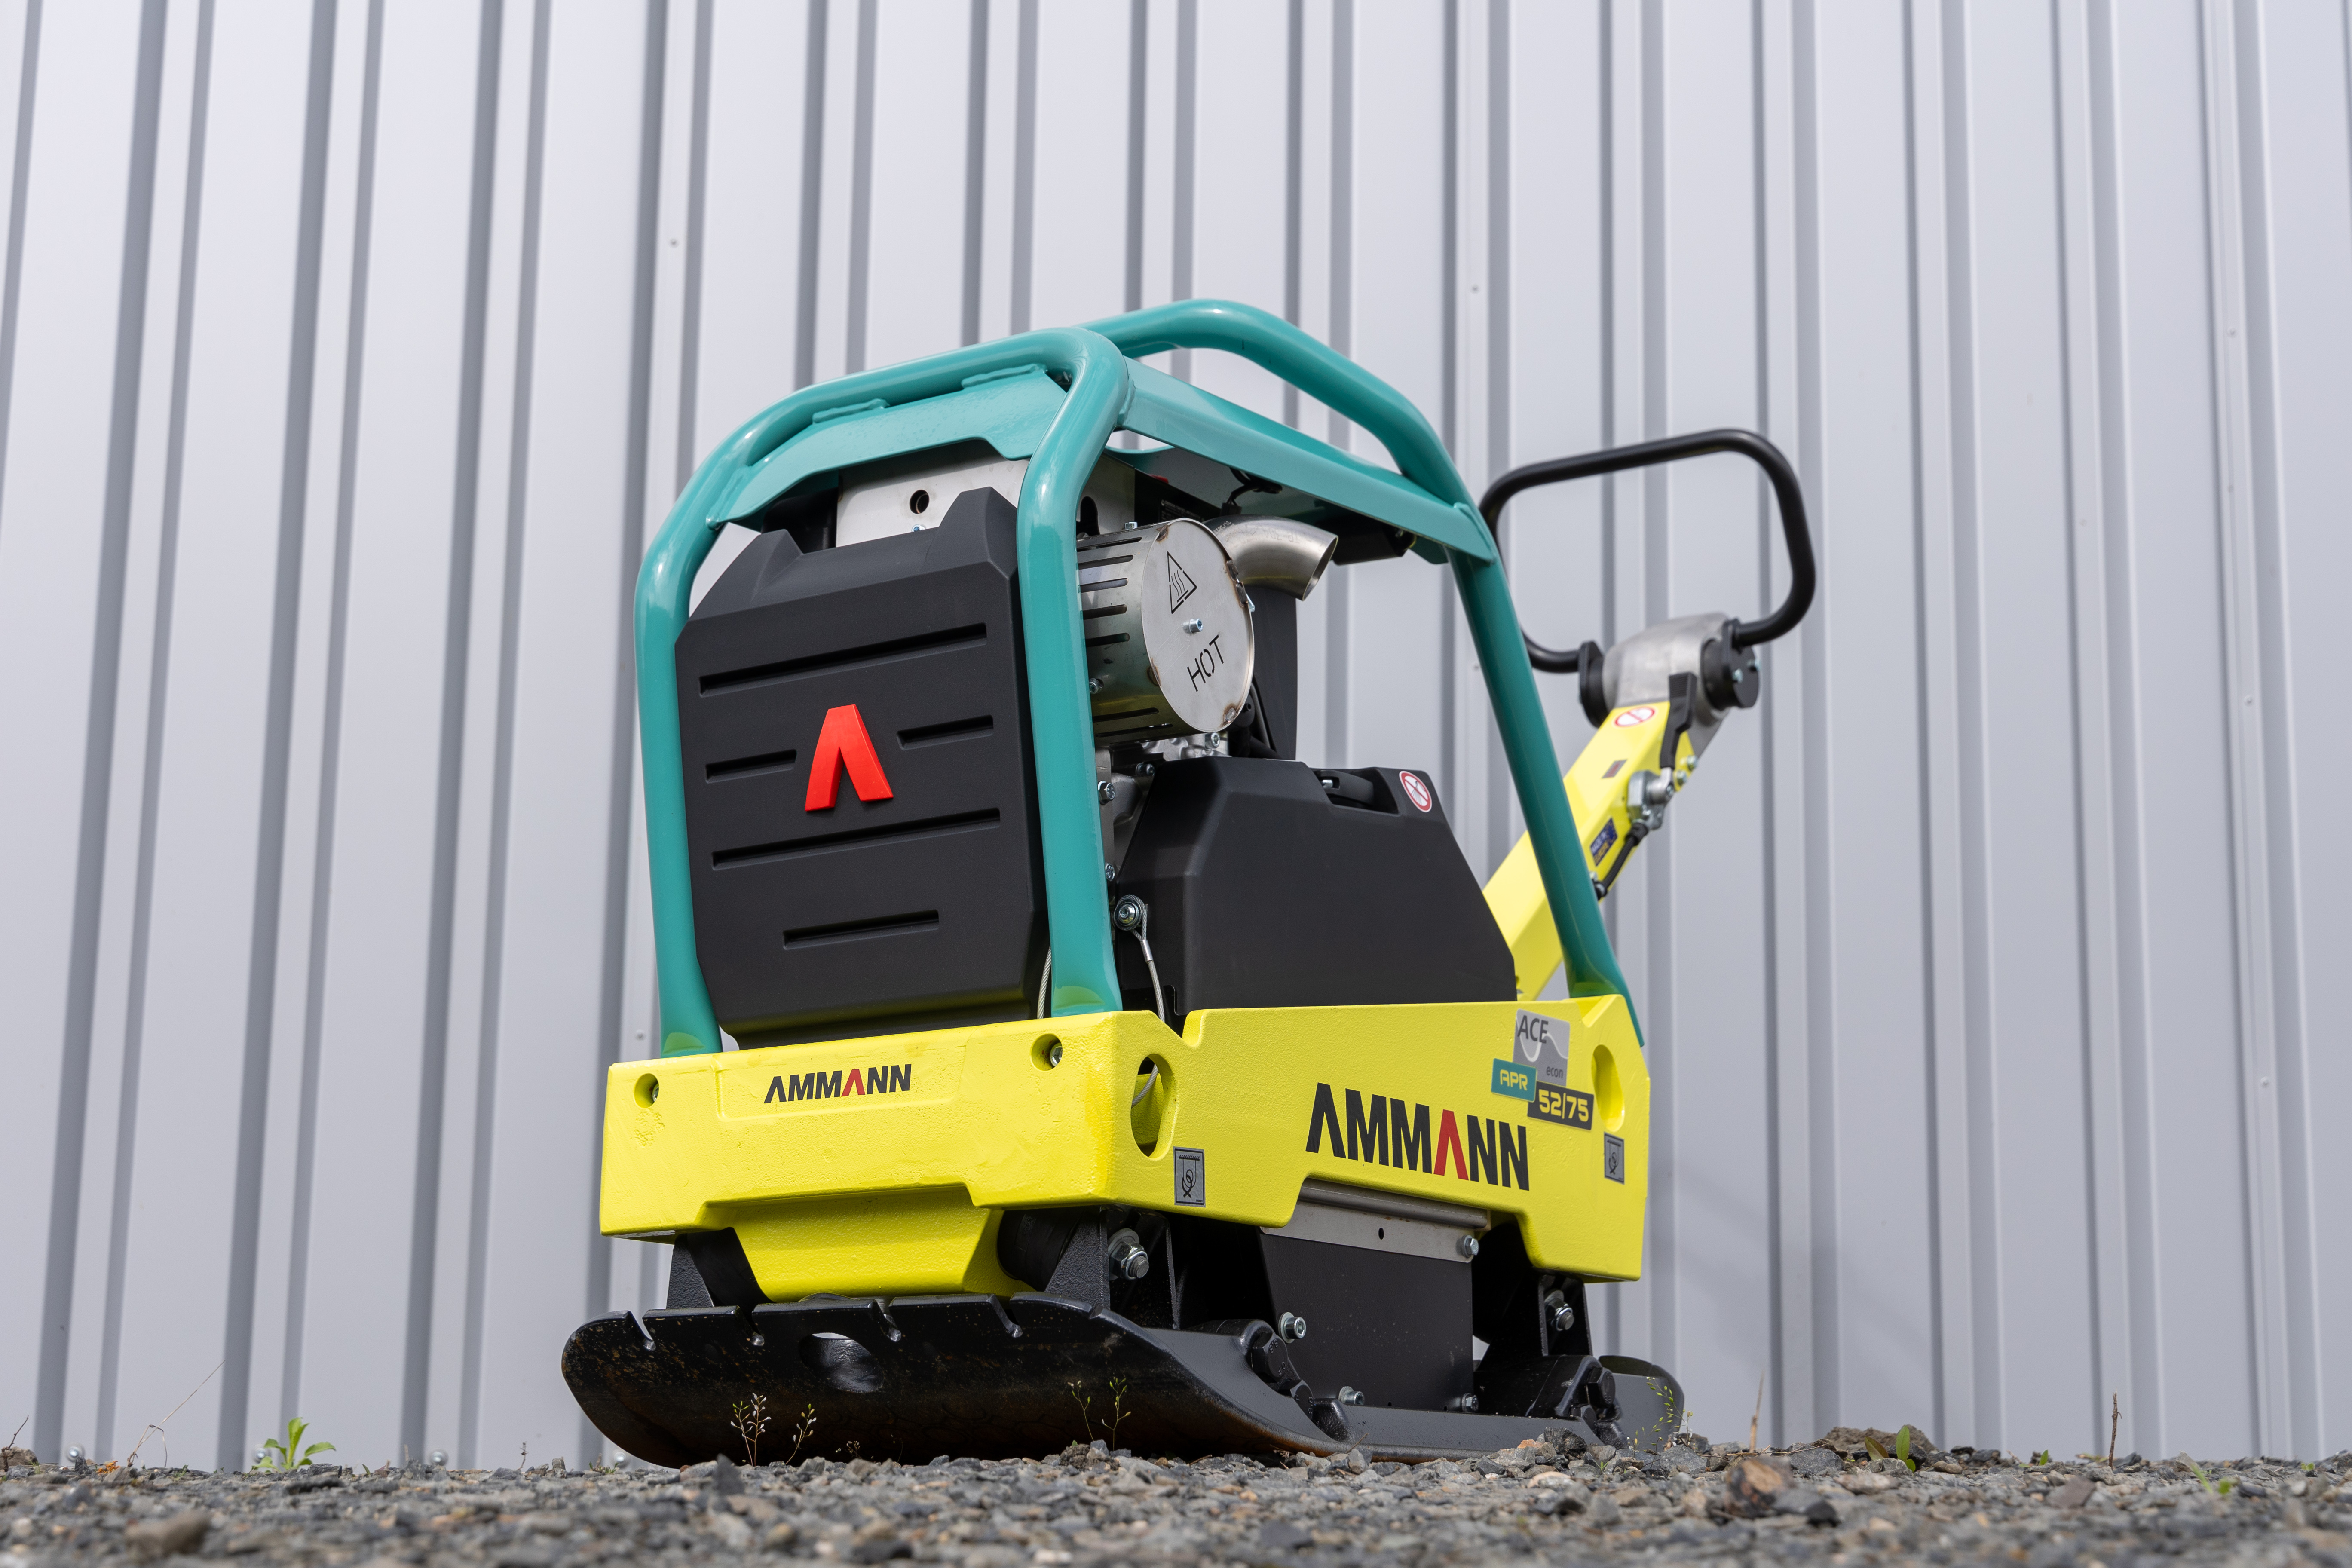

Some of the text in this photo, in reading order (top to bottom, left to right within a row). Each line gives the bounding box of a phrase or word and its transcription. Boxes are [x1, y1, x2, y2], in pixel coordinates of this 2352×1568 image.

[1187, 634, 1224, 692] HOT
[1517, 1015, 1549, 1044] ACE
[763, 1063, 912, 1104] AMMANN
[1500, 1069, 1528, 1091] APR
[1546, 1066, 1563, 1079] econ
[1305, 1082, 1530, 1191] AMMANN
